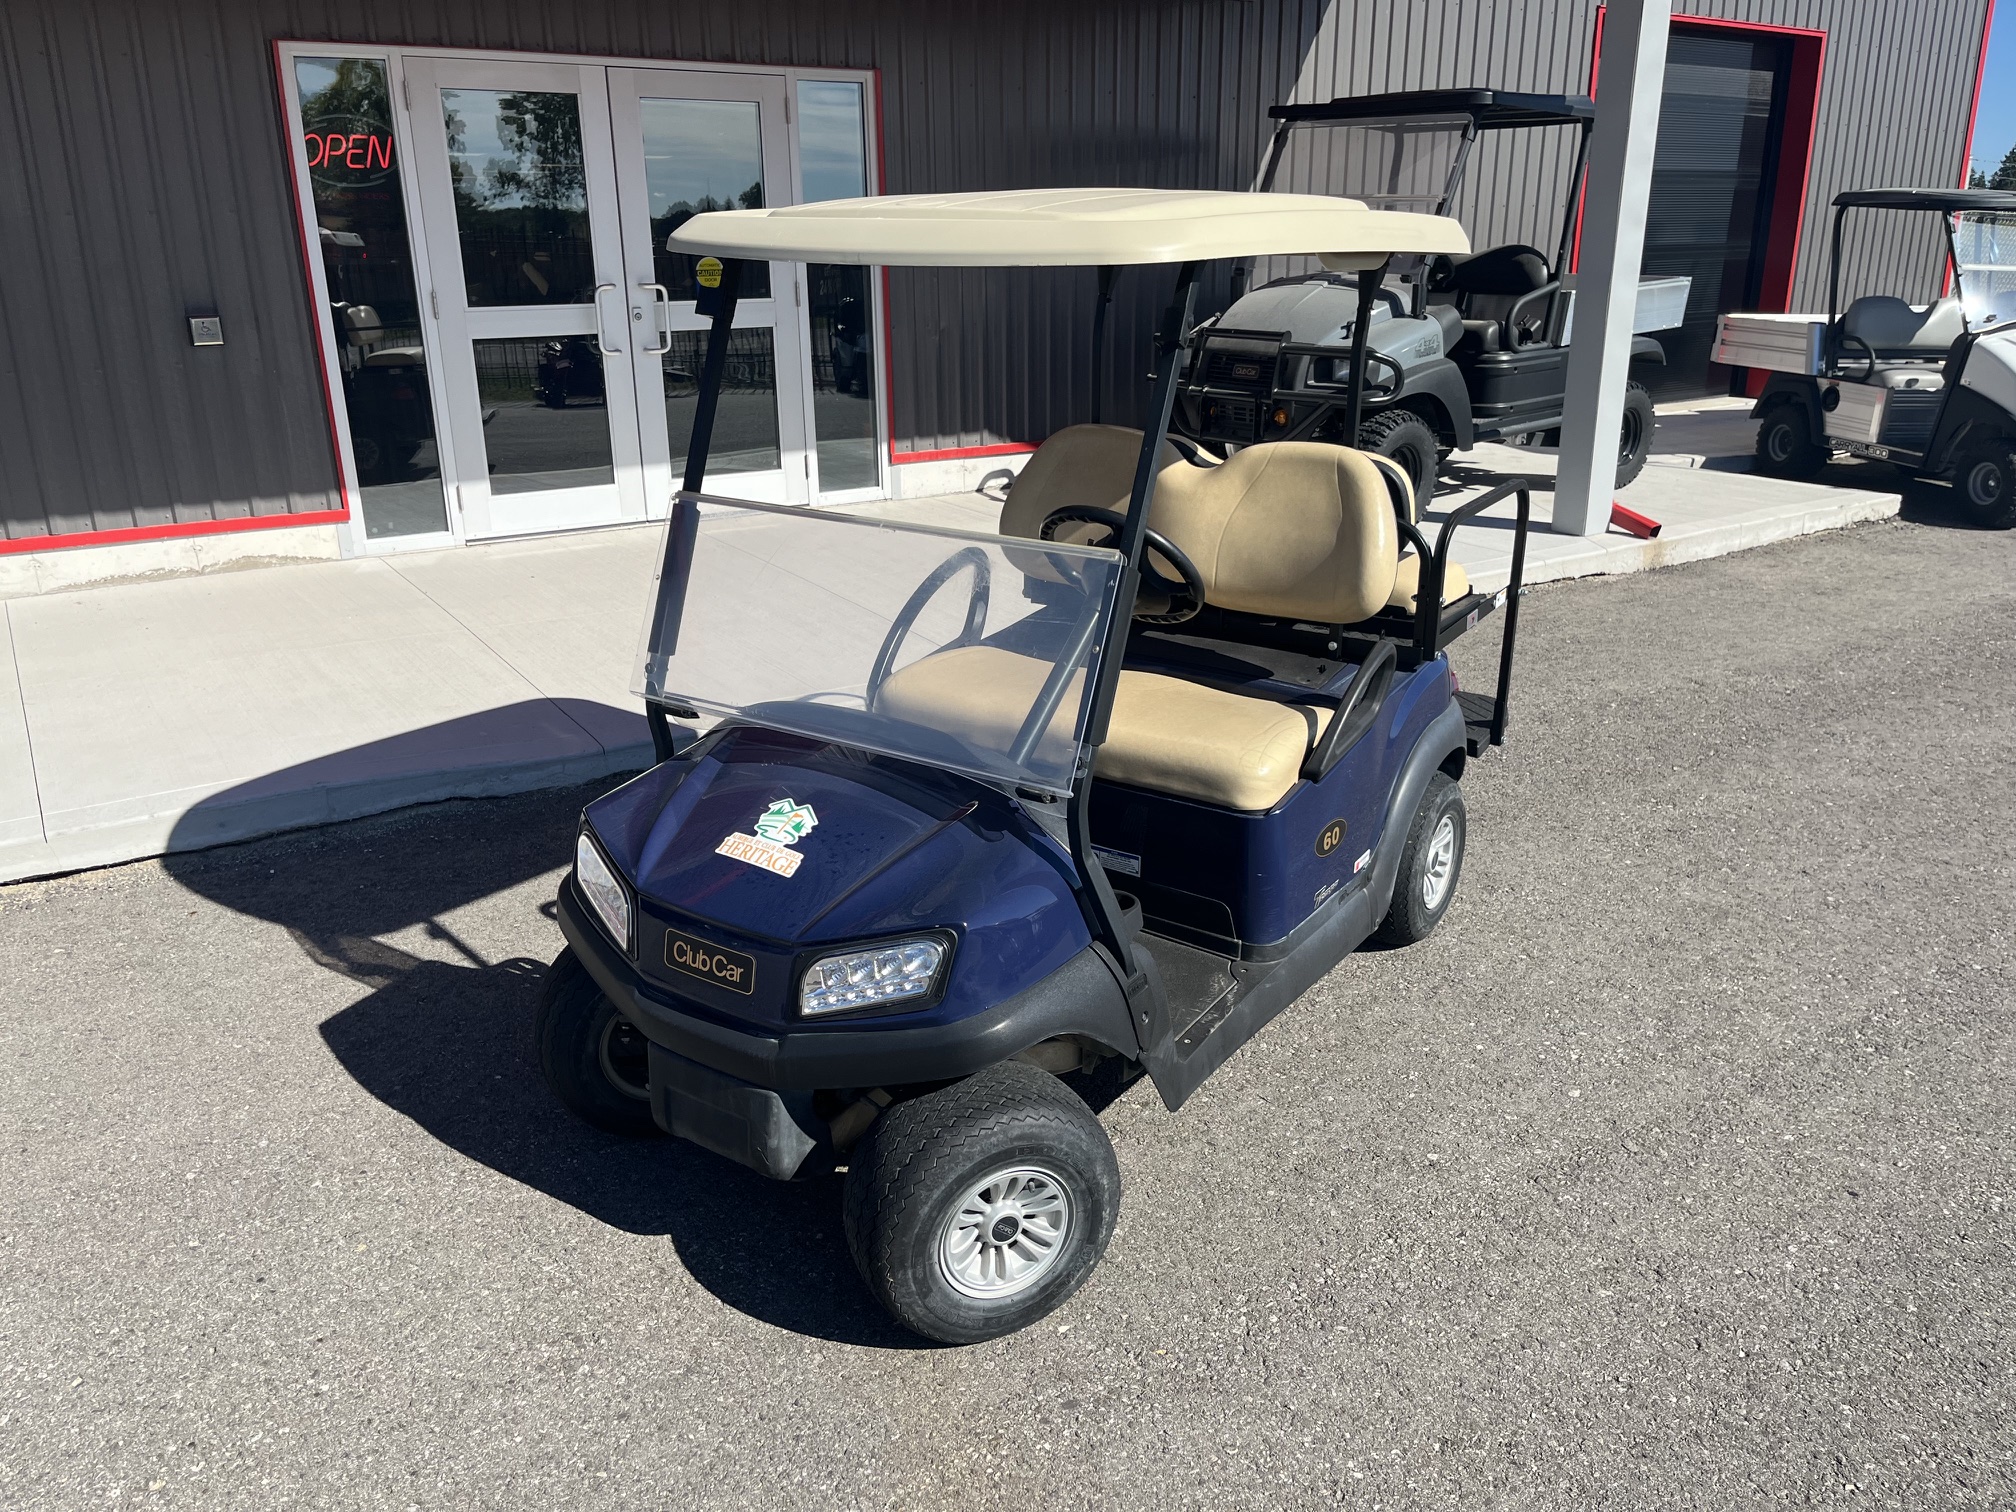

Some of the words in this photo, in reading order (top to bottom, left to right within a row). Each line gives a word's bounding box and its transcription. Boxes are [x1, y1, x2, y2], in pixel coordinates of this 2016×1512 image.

[304, 133, 392, 169] OPEN
[1829, 437, 1867, 455] CARRYALL
[1868, 446, 1888, 459] 300
[1323, 826, 1340, 851] 60
[718, 838, 799, 876] HERITAGE
[784, 850, 802, 860] GOLF
[673, 940, 711, 972] Club
[712, 954, 744, 983] Car
